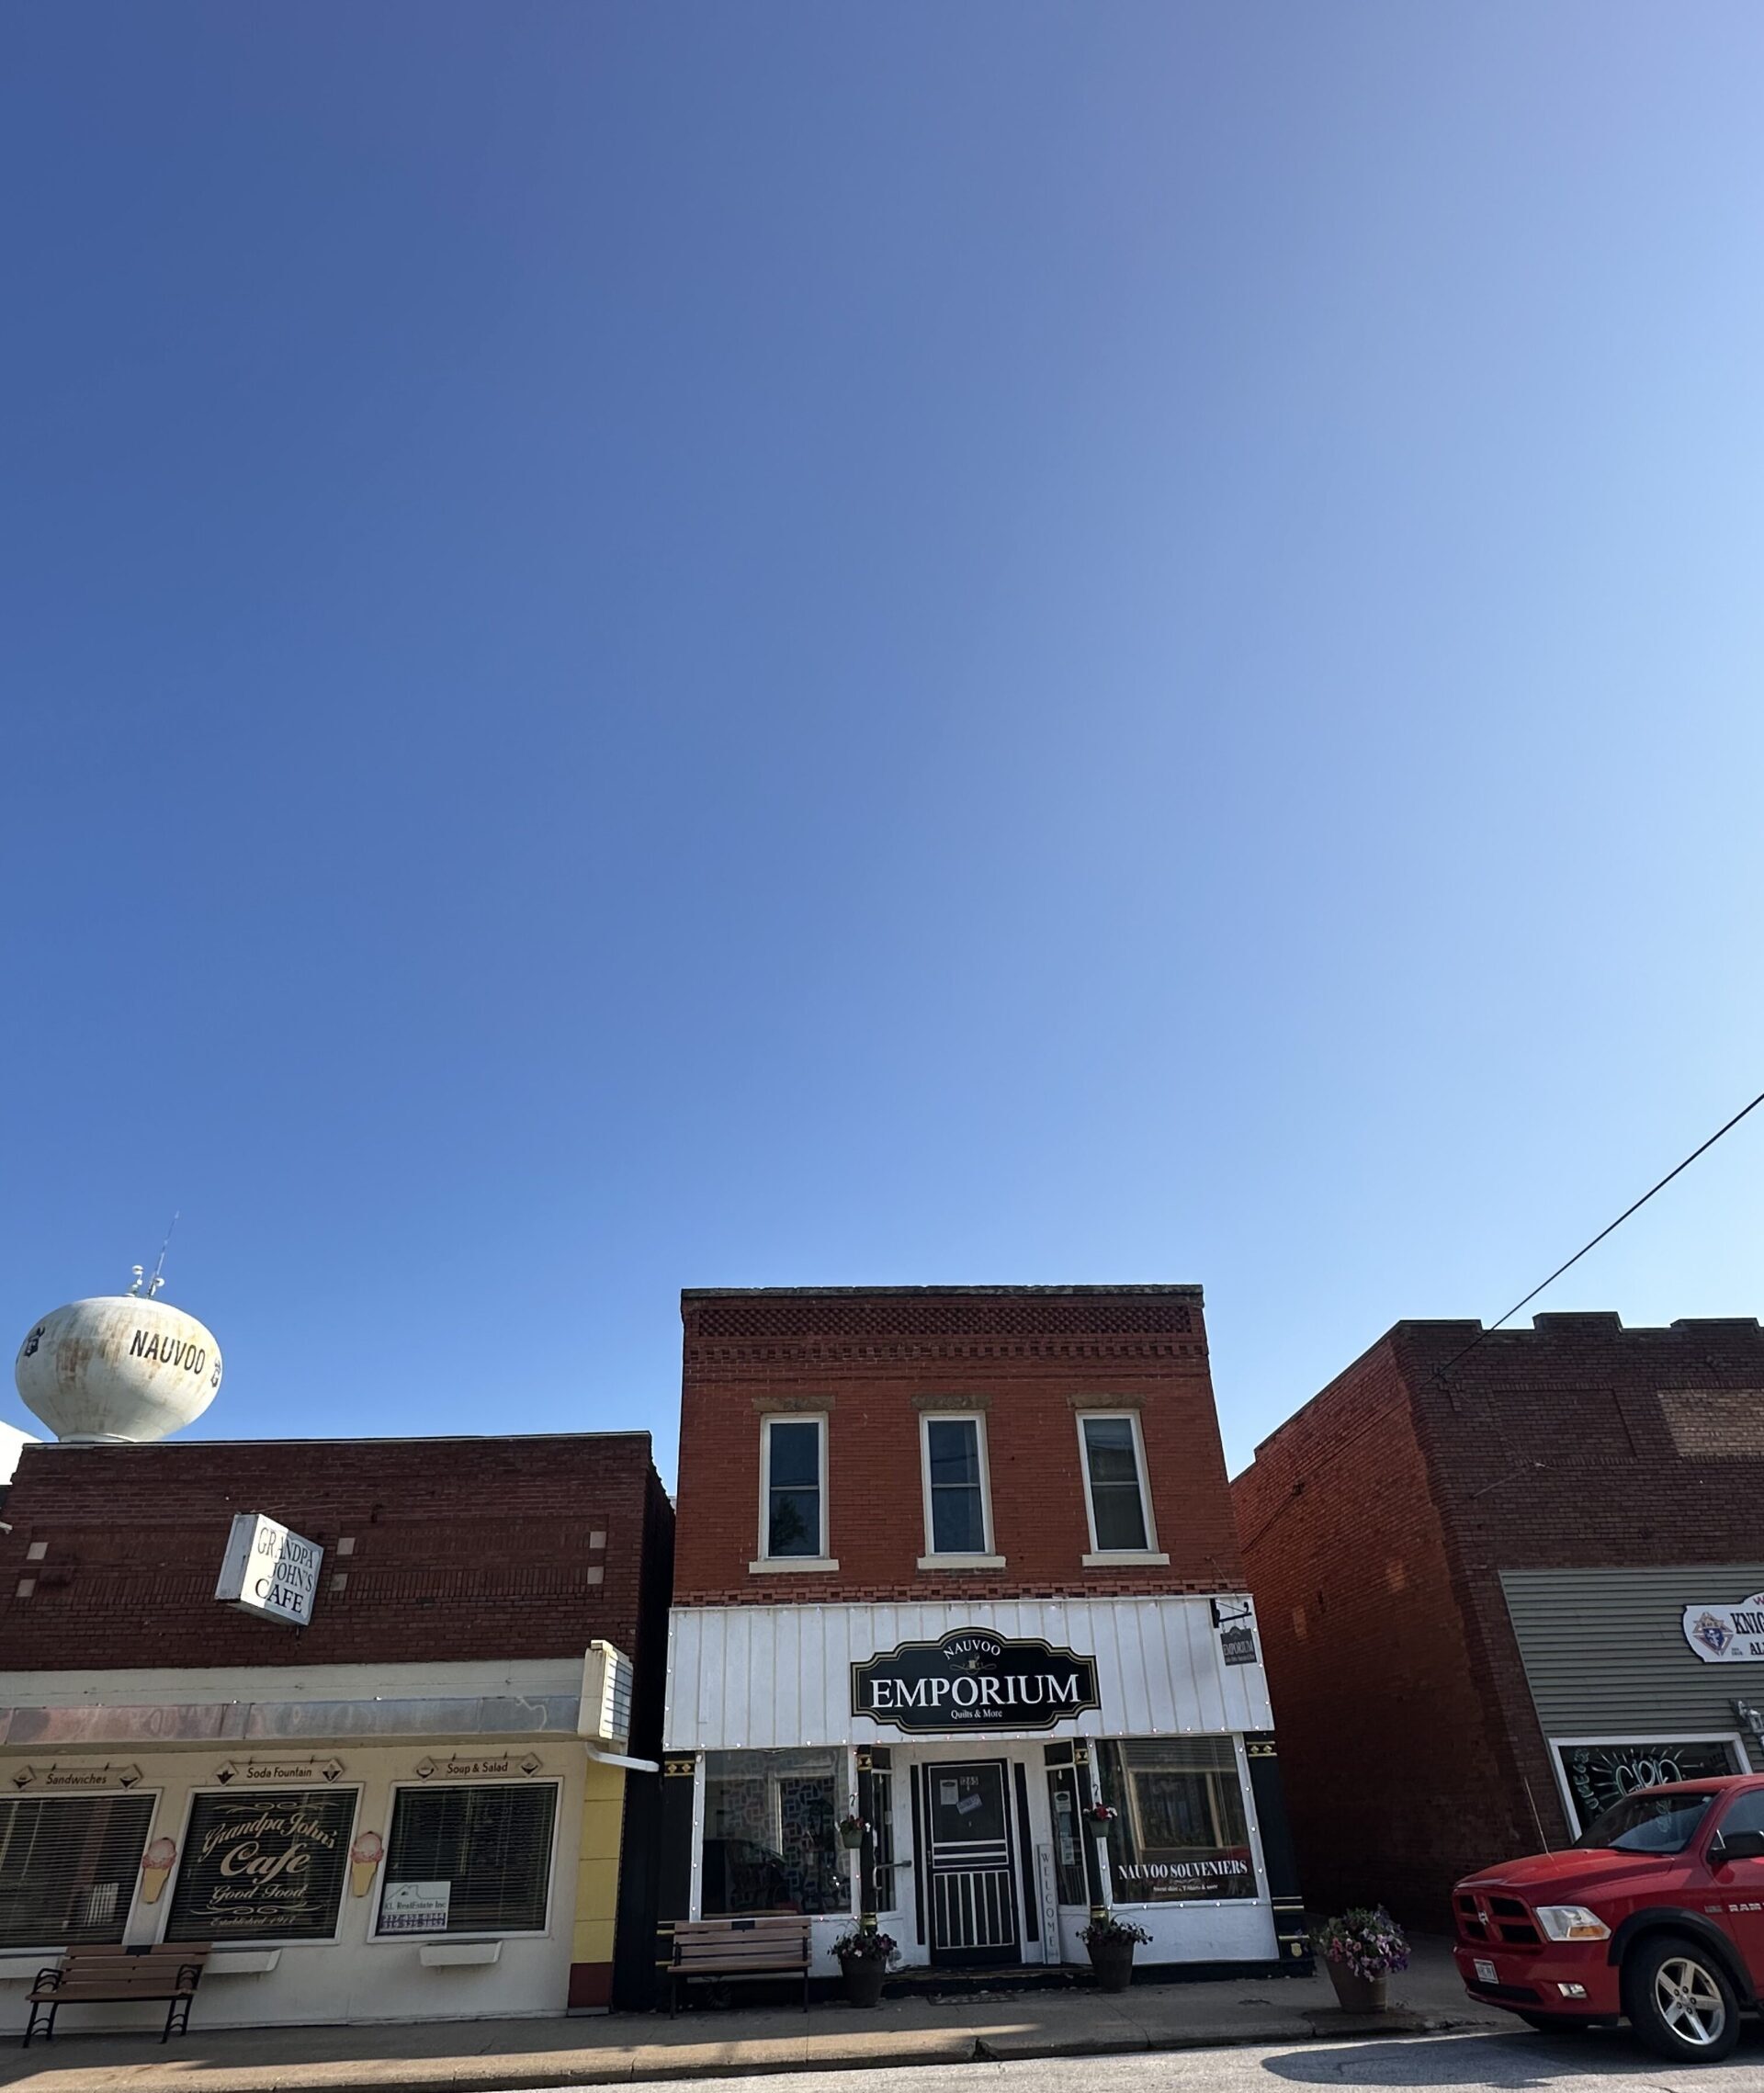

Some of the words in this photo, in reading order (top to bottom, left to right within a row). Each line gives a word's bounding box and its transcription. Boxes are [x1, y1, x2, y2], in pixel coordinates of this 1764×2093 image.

[130, 1329, 205, 1375] NAUVOO
[257, 1527, 314, 1568] GRANDPA
[268, 1562, 313, 1592] JOHN'S
[255, 1578, 303, 1613] CAFE
[943, 1639, 1001, 1660] NAUVOO
[870, 1674, 1081, 1709] EMPORIUM
[951, 1709, 973, 1720] Quilts
[974, 1709, 981, 1718] &
[982, 1708, 1002, 1718] More
[46, 1773, 107, 1784] Sandwiches
[246, 1768, 271, 1778] Soda
[274, 1767, 312, 1778] Fountain
[447, 1763, 470, 1775] Soup
[472, 1764, 480, 1772] &
[482, 1761, 508, 1772] Salad
[198, 1812, 285, 1862] Grandpa
[280, 1813, 337, 1849] John's
[220, 1840, 311, 1884] Cafe
[1118, 1864, 1168, 1880] NAUVOO
[1170, 1860, 1248, 1878] SOUVENIERS
[209, 1885, 259, 1904] Good
[262, 1884, 308, 1898] Food
[1041, 1852, 1055, 1948] WELCOME
[1728, 1903, 1762, 1912] RAM
